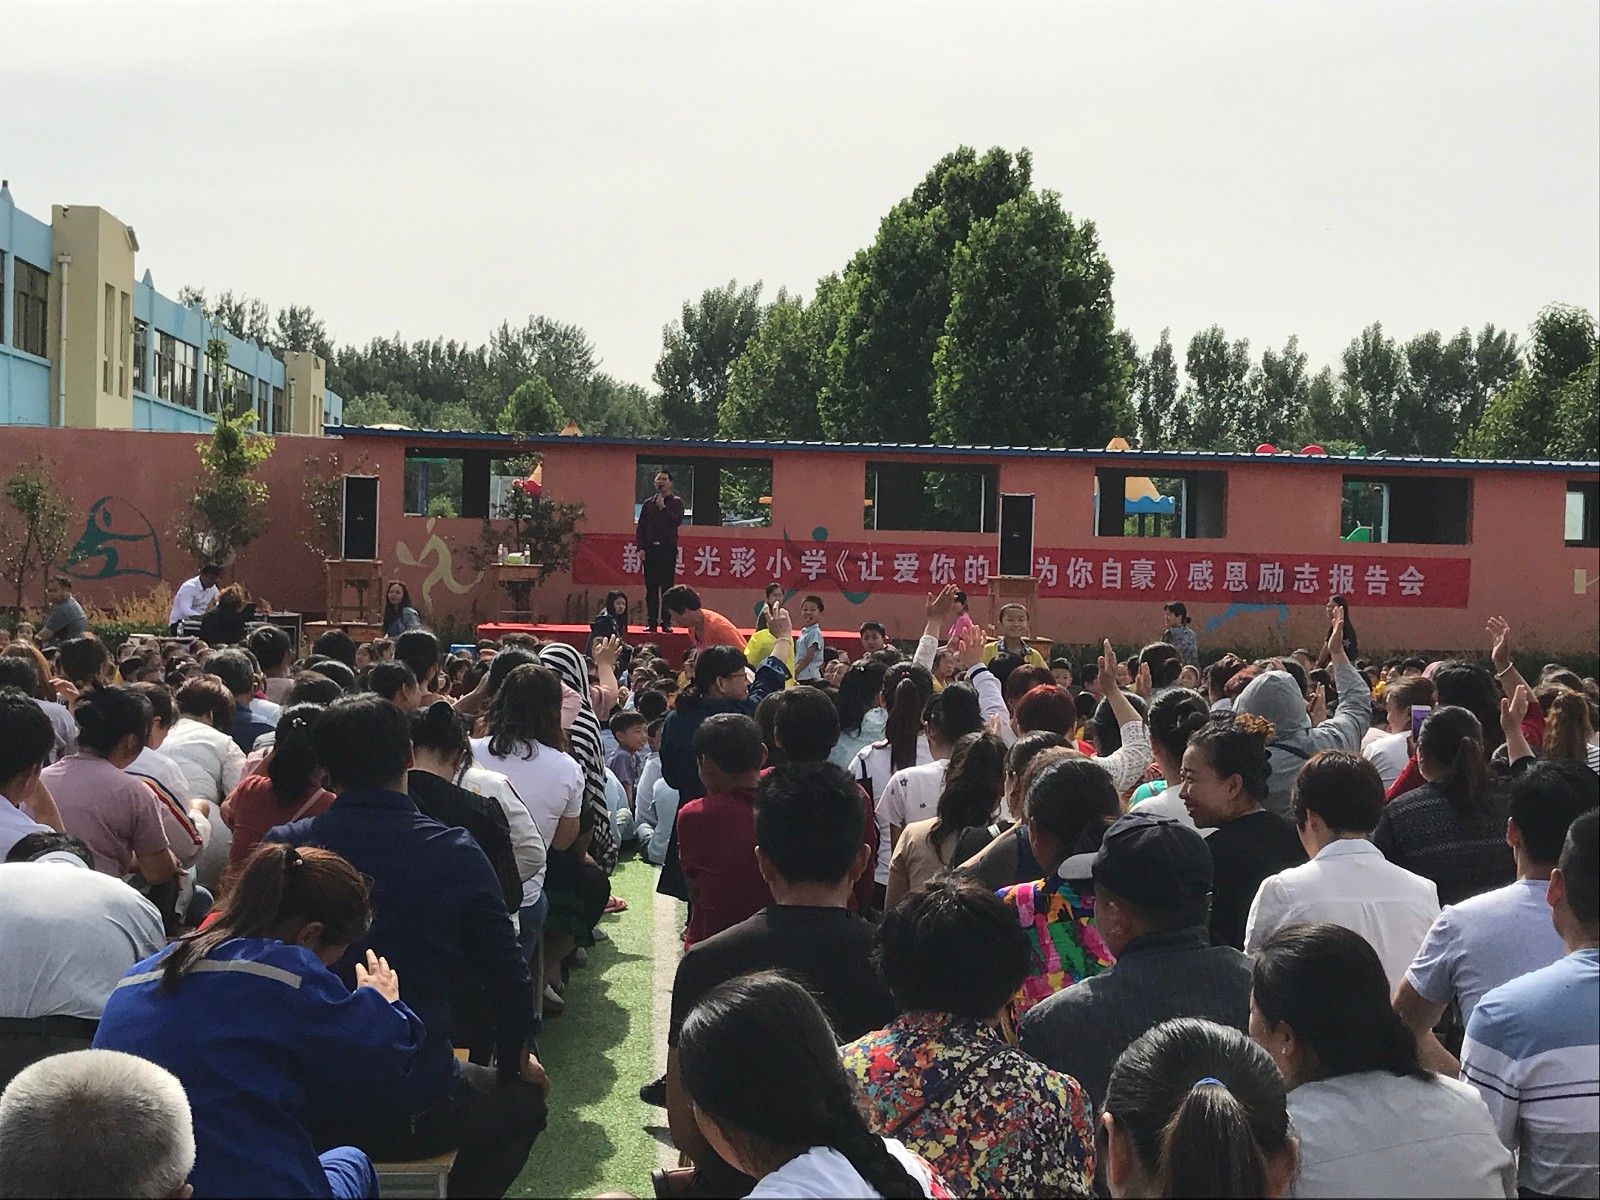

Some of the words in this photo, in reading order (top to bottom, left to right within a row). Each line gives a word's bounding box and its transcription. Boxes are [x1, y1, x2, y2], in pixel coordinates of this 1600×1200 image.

[622, 542, 1426, 596] 新光彩小学《让爱你的为你自豪》感恩励志报告会
